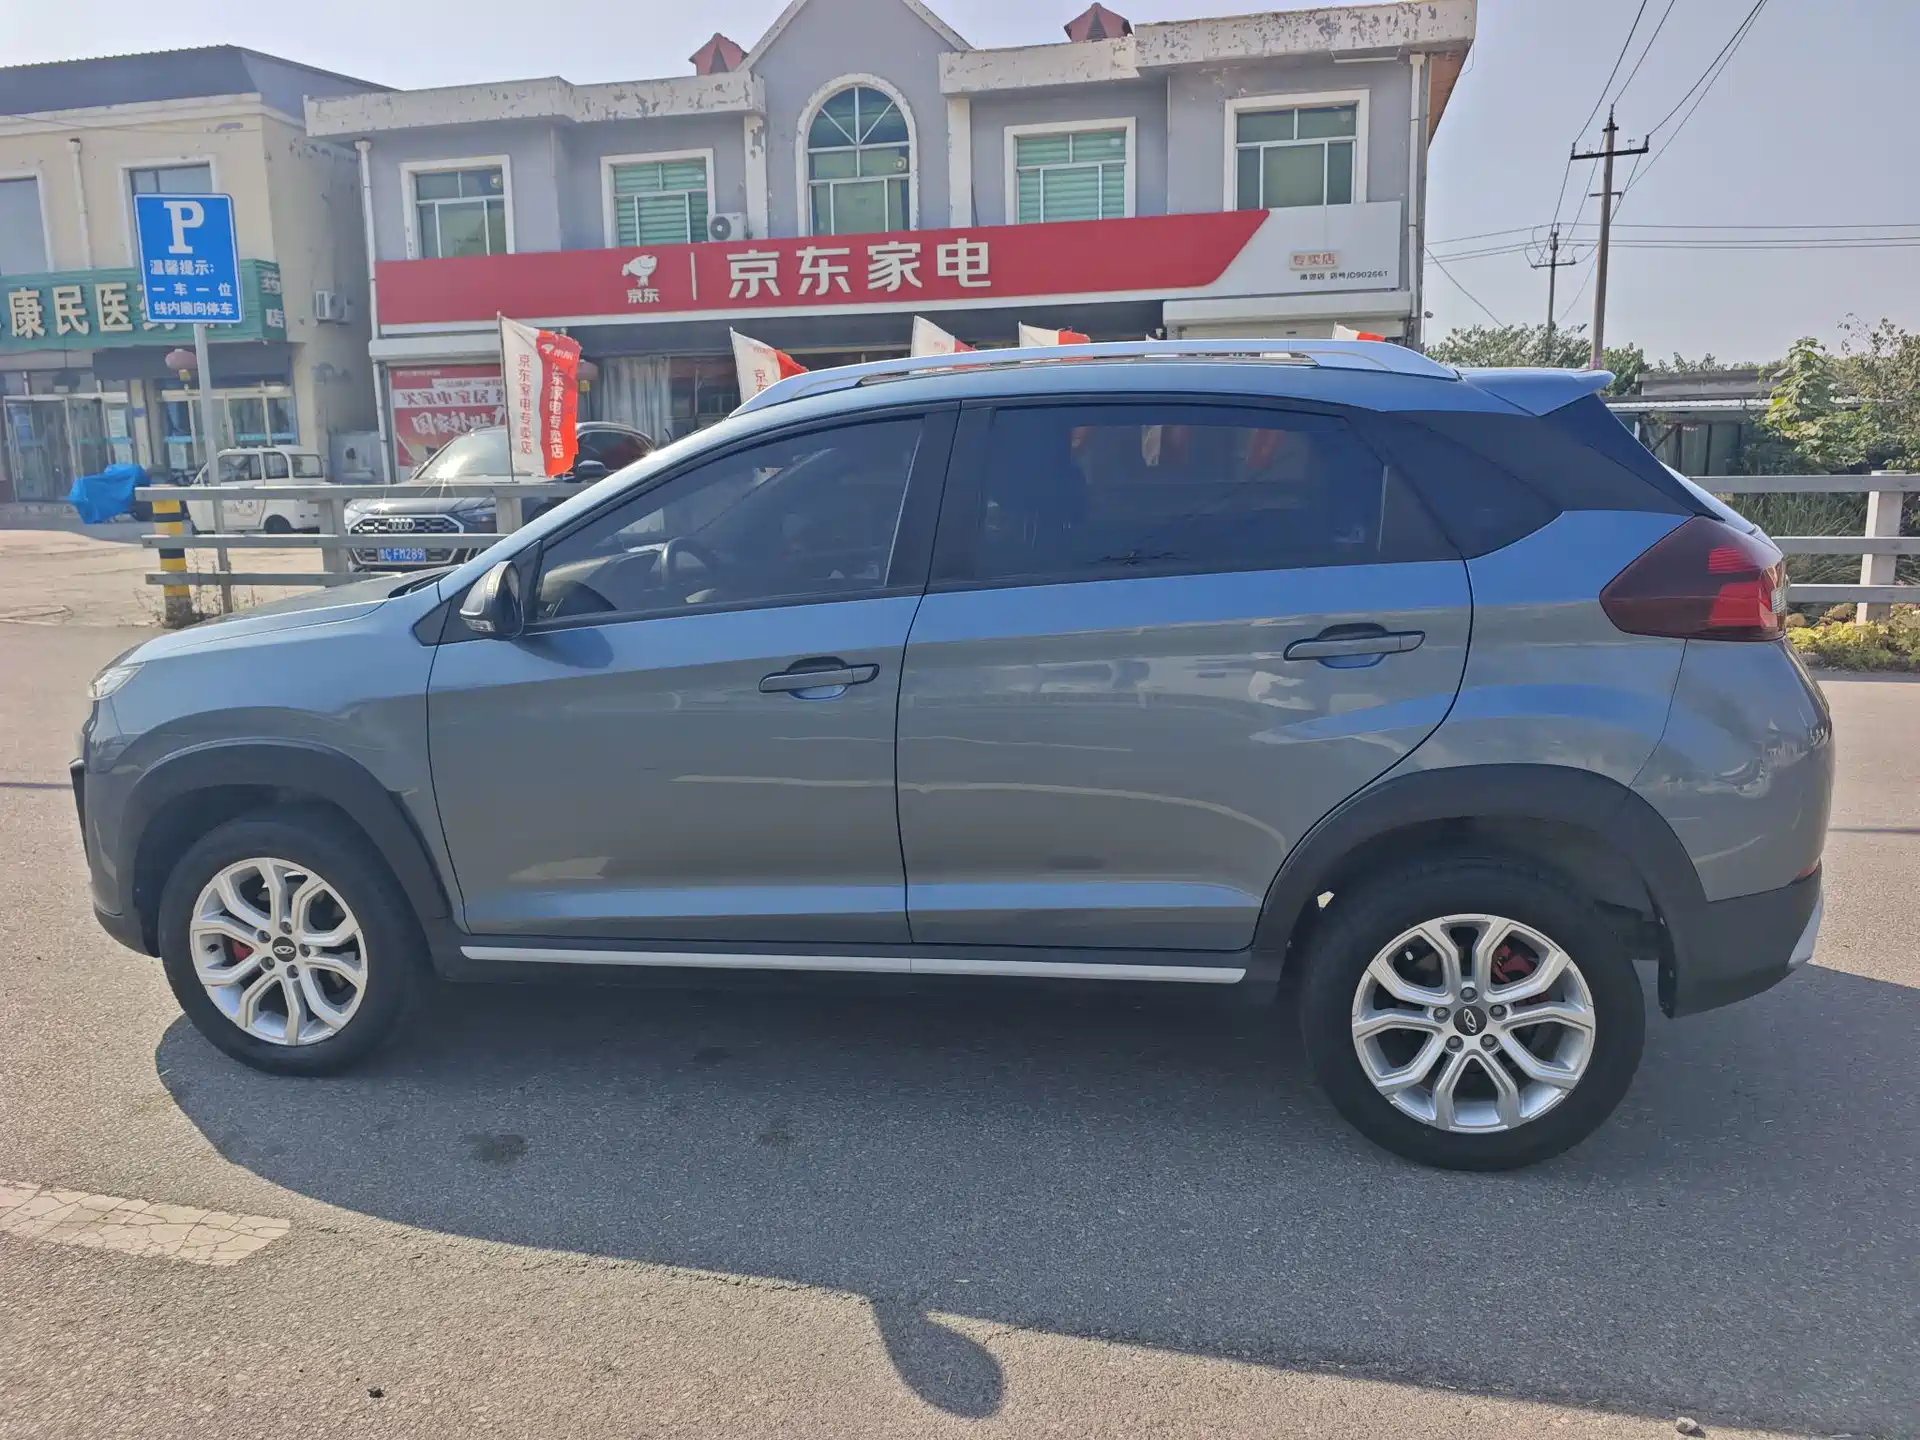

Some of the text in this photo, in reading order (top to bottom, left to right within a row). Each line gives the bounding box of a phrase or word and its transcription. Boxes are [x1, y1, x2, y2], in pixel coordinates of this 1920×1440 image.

[163, 200, 205, 253] P
[627, 288, 660, 304] 京东
[727, 238, 991, 299] 京东家电
[8, 282, 176, 341] 康民医
[154, 301, 234, 316] 线内顺向停车
[518, 354, 532, 454] 京东家电专卖店
